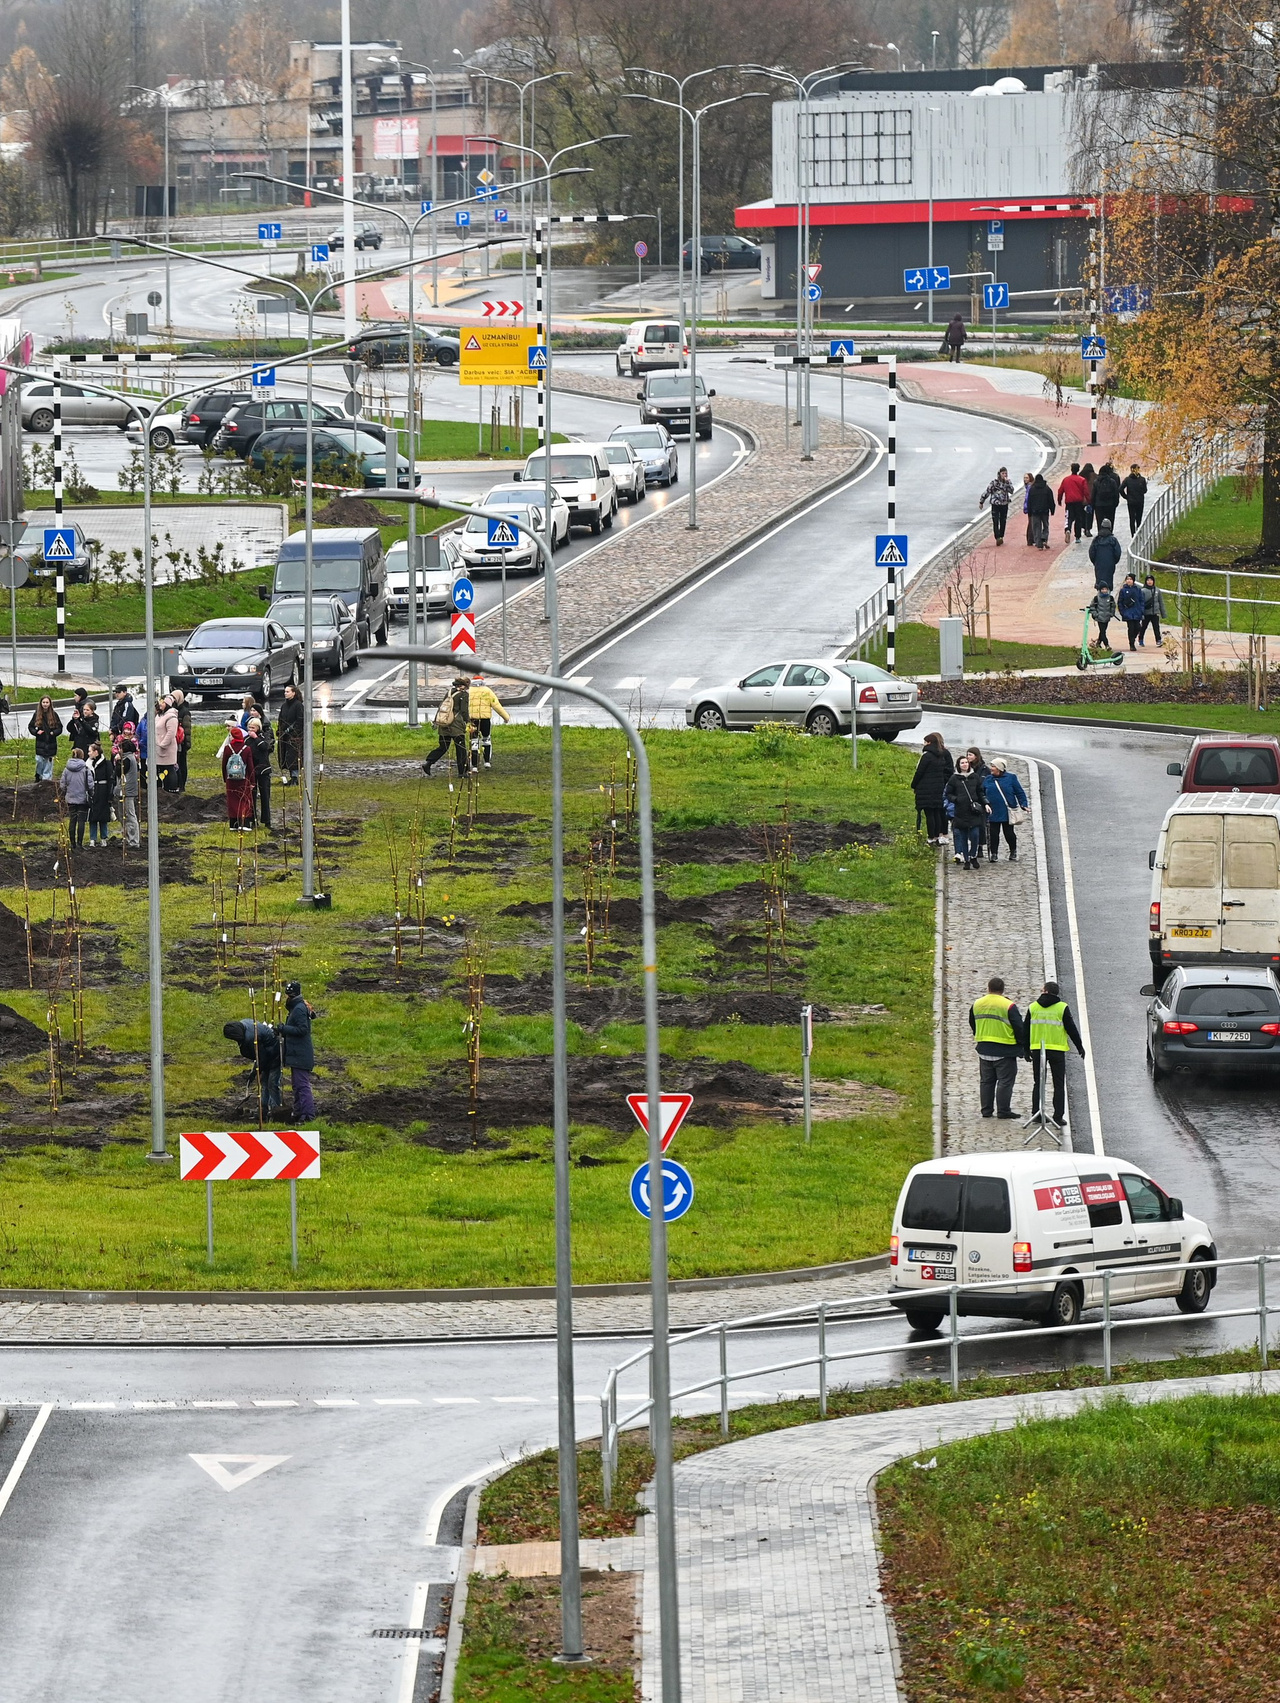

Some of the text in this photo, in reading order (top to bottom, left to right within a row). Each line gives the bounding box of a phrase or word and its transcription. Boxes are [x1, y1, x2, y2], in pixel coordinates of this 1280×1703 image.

[459, 213, 468, 224] P
[991, 220, 1001, 233] P
[257, 365, 270, 384] P
[1174, 929, 1209, 937] KR03 ZJZ
[1062, 1186, 1080, 1196] INTER
[1065, 1195, 1083, 1205] CARS
